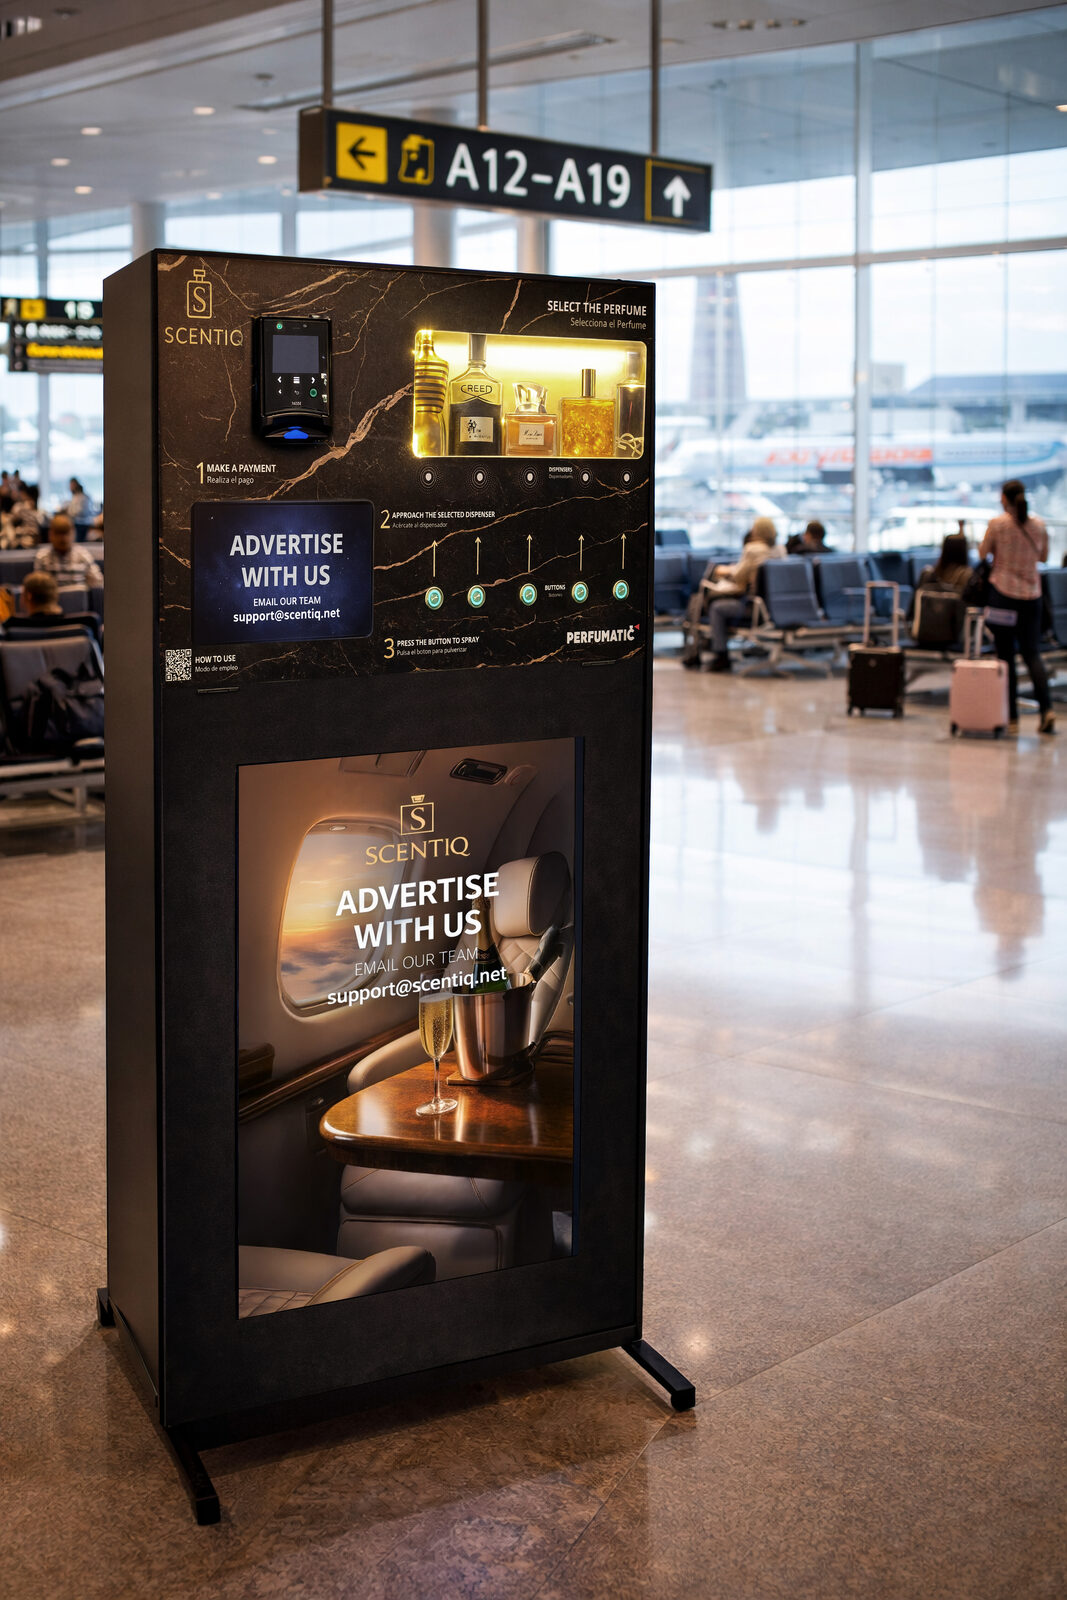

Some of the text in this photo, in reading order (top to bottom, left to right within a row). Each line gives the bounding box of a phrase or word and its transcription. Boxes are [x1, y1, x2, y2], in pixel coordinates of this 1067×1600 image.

[547, 300, 647, 316] SELECT THE PERFUME
[570, 317, 647, 330] Selecciona el Perfume
[164, 327, 243, 347] SCENTIQ
[460, 384, 492, 394] CREED
[196, 461, 204, 485] 1
[206, 464, 276, 473] MAKE A PAYMENT
[206, 476, 254, 486] Realiza el pago
[380, 509, 390, 529] 2
[419, 522, 448, 530] dispensador
[230, 534, 344, 556] ADVERTISE
[242, 564, 330, 588] WITH US
[254, 596, 320, 606] EMAIL OUR TEAM
[233, 608, 340, 624] support@scentiq.net
[384, 638, 394, 658] 3
[195, 656, 212, 664] HOW
[366, 836, 470, 865] SCENTIQ
[336, 872, 500, 917] ADVERTISE
[354, 910, 482, 950] WITH US
[354, 947, 478, 976] EMAIL OUR TEAM
[327, 966, 507, 1006] support@scentiq.net
